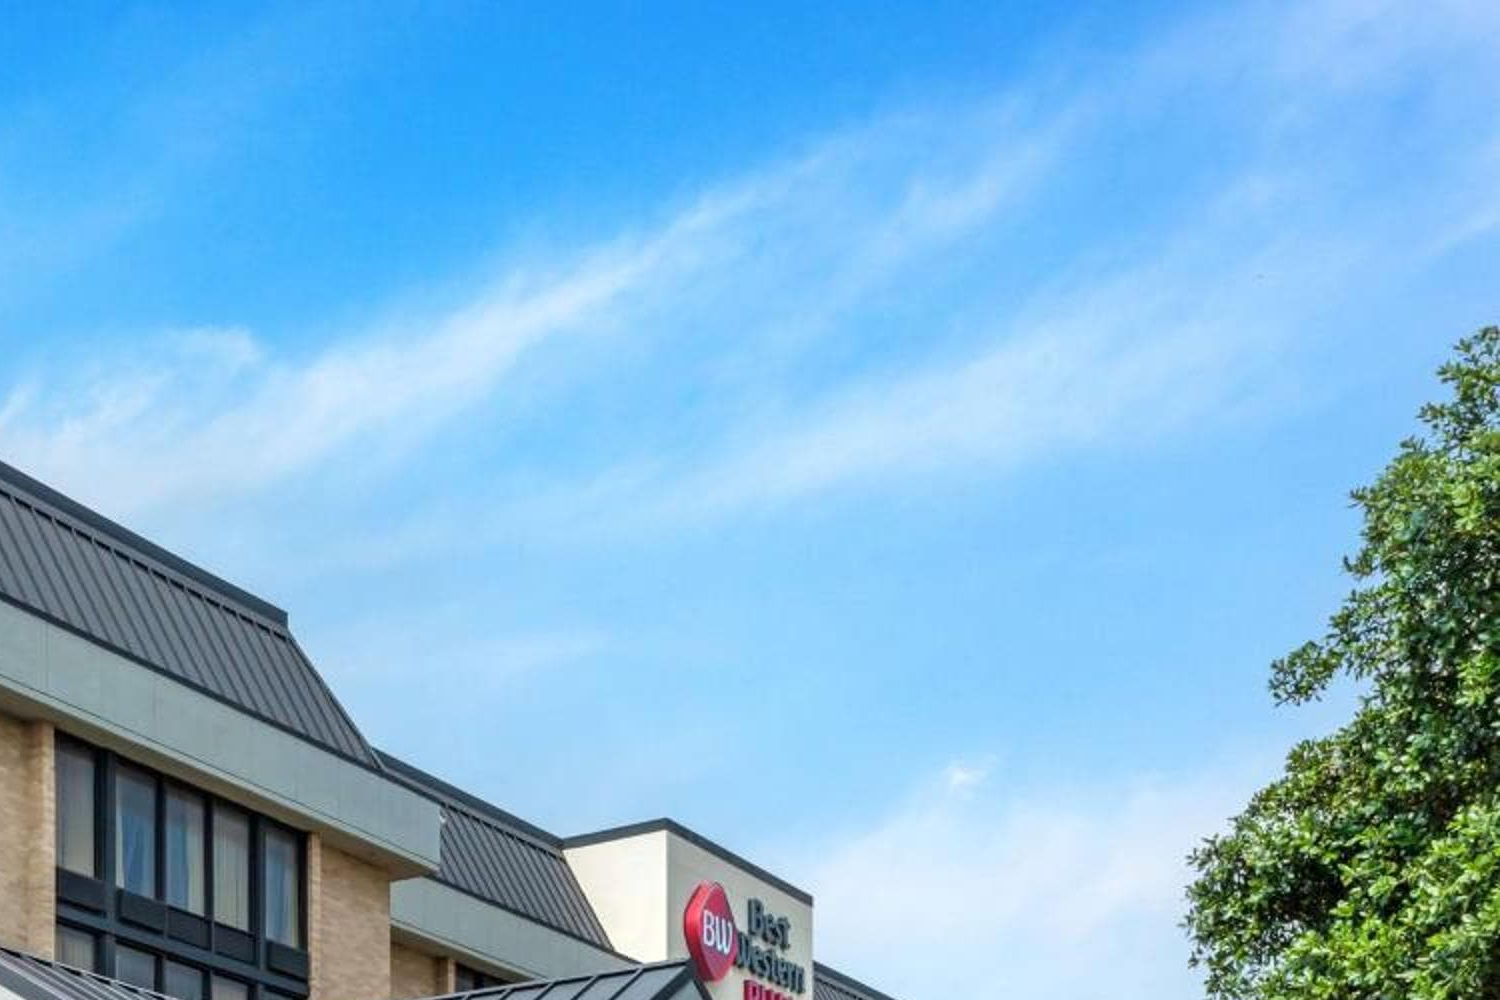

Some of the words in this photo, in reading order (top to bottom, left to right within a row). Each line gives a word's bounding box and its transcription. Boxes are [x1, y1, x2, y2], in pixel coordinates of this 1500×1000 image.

[703, 910, 733, 956] BW
[747, 898, 791, 950] Best
[737, 931, 806, 994] Western
